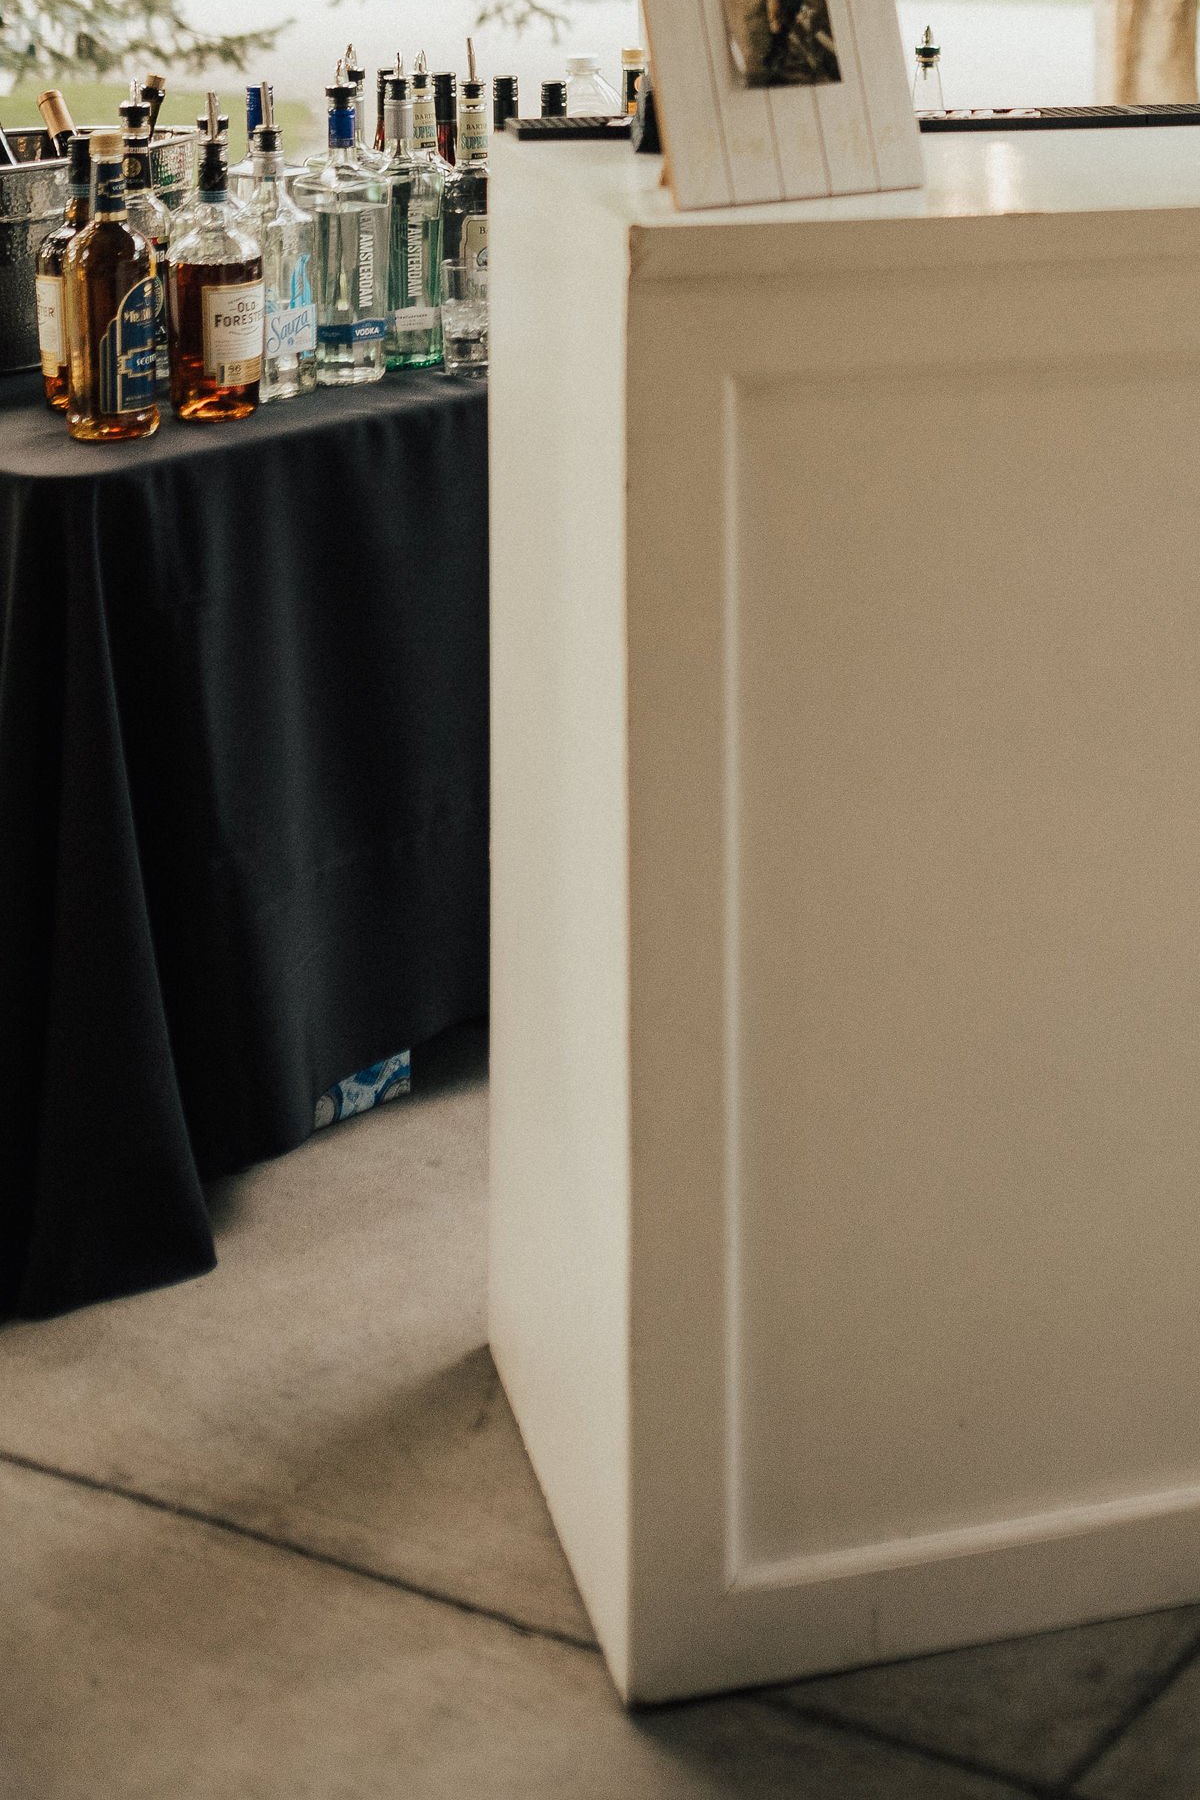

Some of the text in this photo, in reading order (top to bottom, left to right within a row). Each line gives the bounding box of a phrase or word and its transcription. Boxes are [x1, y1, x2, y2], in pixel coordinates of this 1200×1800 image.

[359, 234, 374, 308] AMSTERDAM
[407, 227, 423, 297] AMSTERDAM
[214, 312, 264, 328] FORESTE
[237, 301, 256, 312] OLD
[267, 310, 310, 353] Sauza
[355, 327, 380, 337] VODKA
